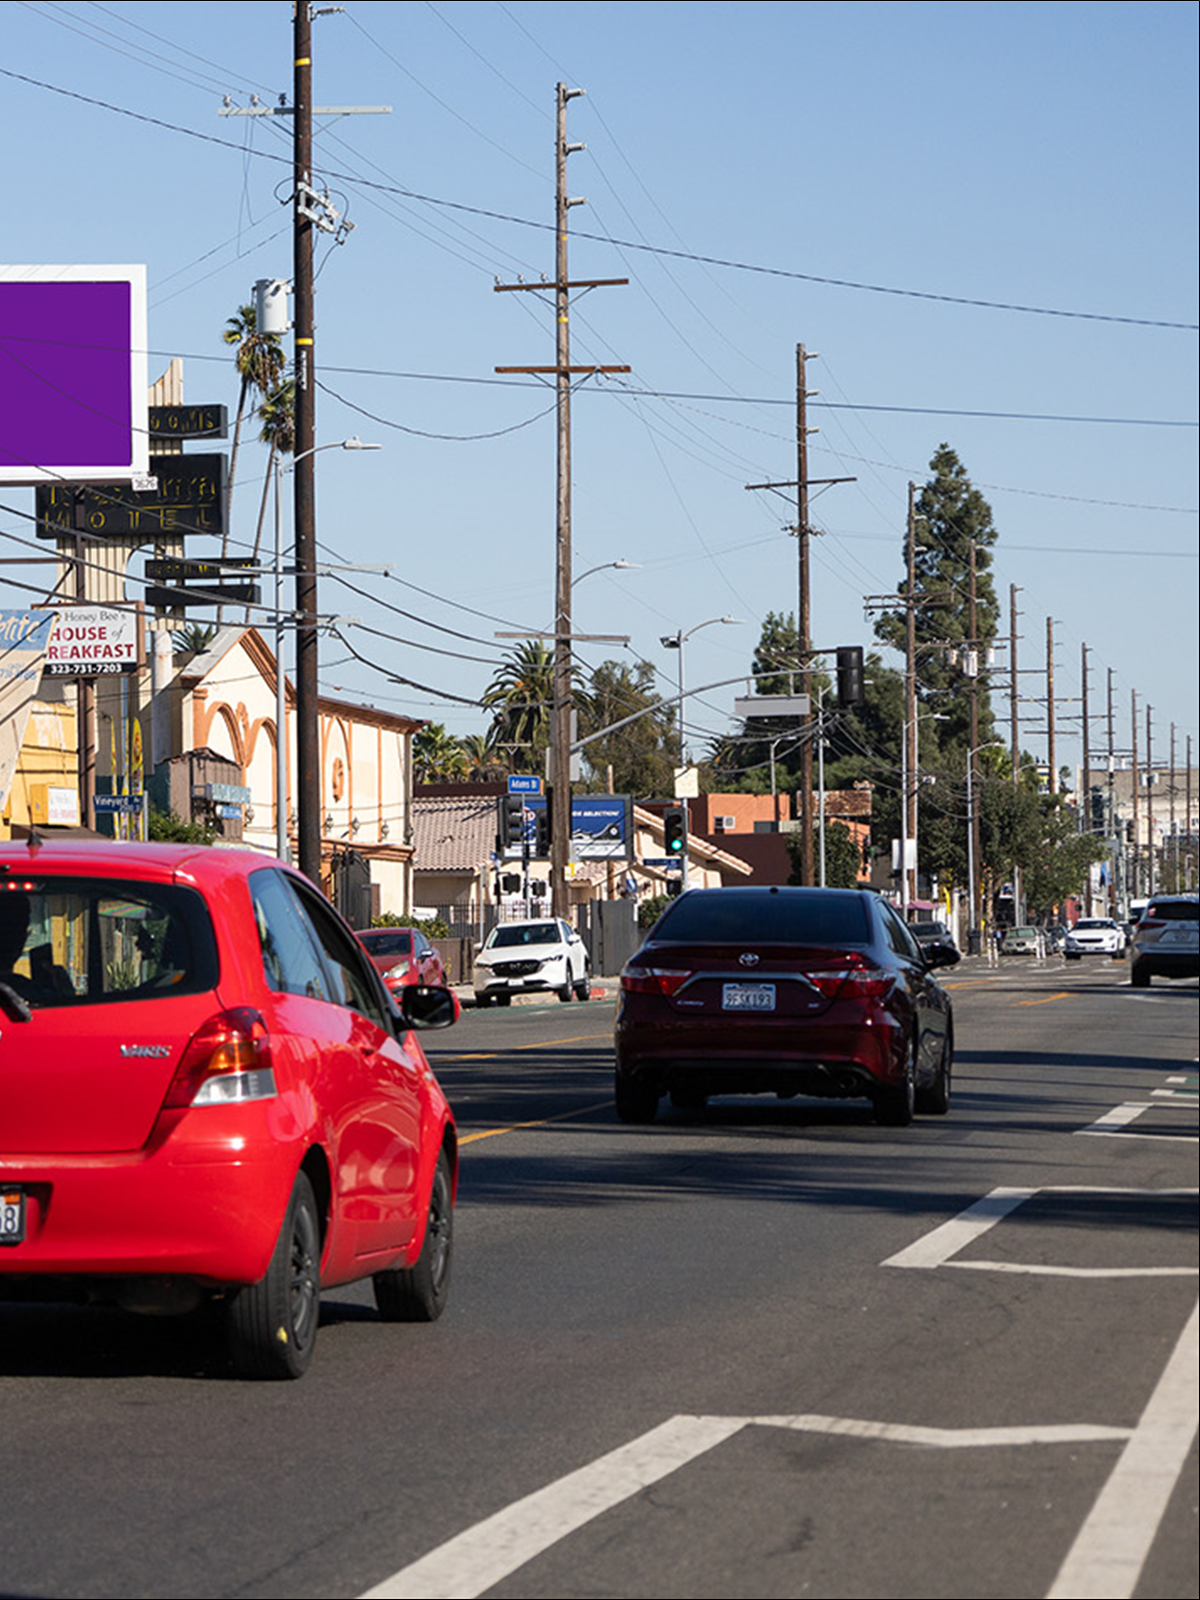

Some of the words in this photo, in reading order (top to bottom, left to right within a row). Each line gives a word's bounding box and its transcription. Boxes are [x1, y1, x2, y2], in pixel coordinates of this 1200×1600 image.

[150, 411, 214, 431] OOMS
[45, 509, 212, 531] MOTEL
[65, 612, 97, 624] Honey
[100, 610, 127, 621] Bee's
[51, 626, 108, 642] HOUSE
[48, 643, 135, 660] REAKFAST
[50, 663, 123, 675] 323-731-7203
[511, 779, 530, 789] Adams
[95, 796, 128, 808] Vineyard
